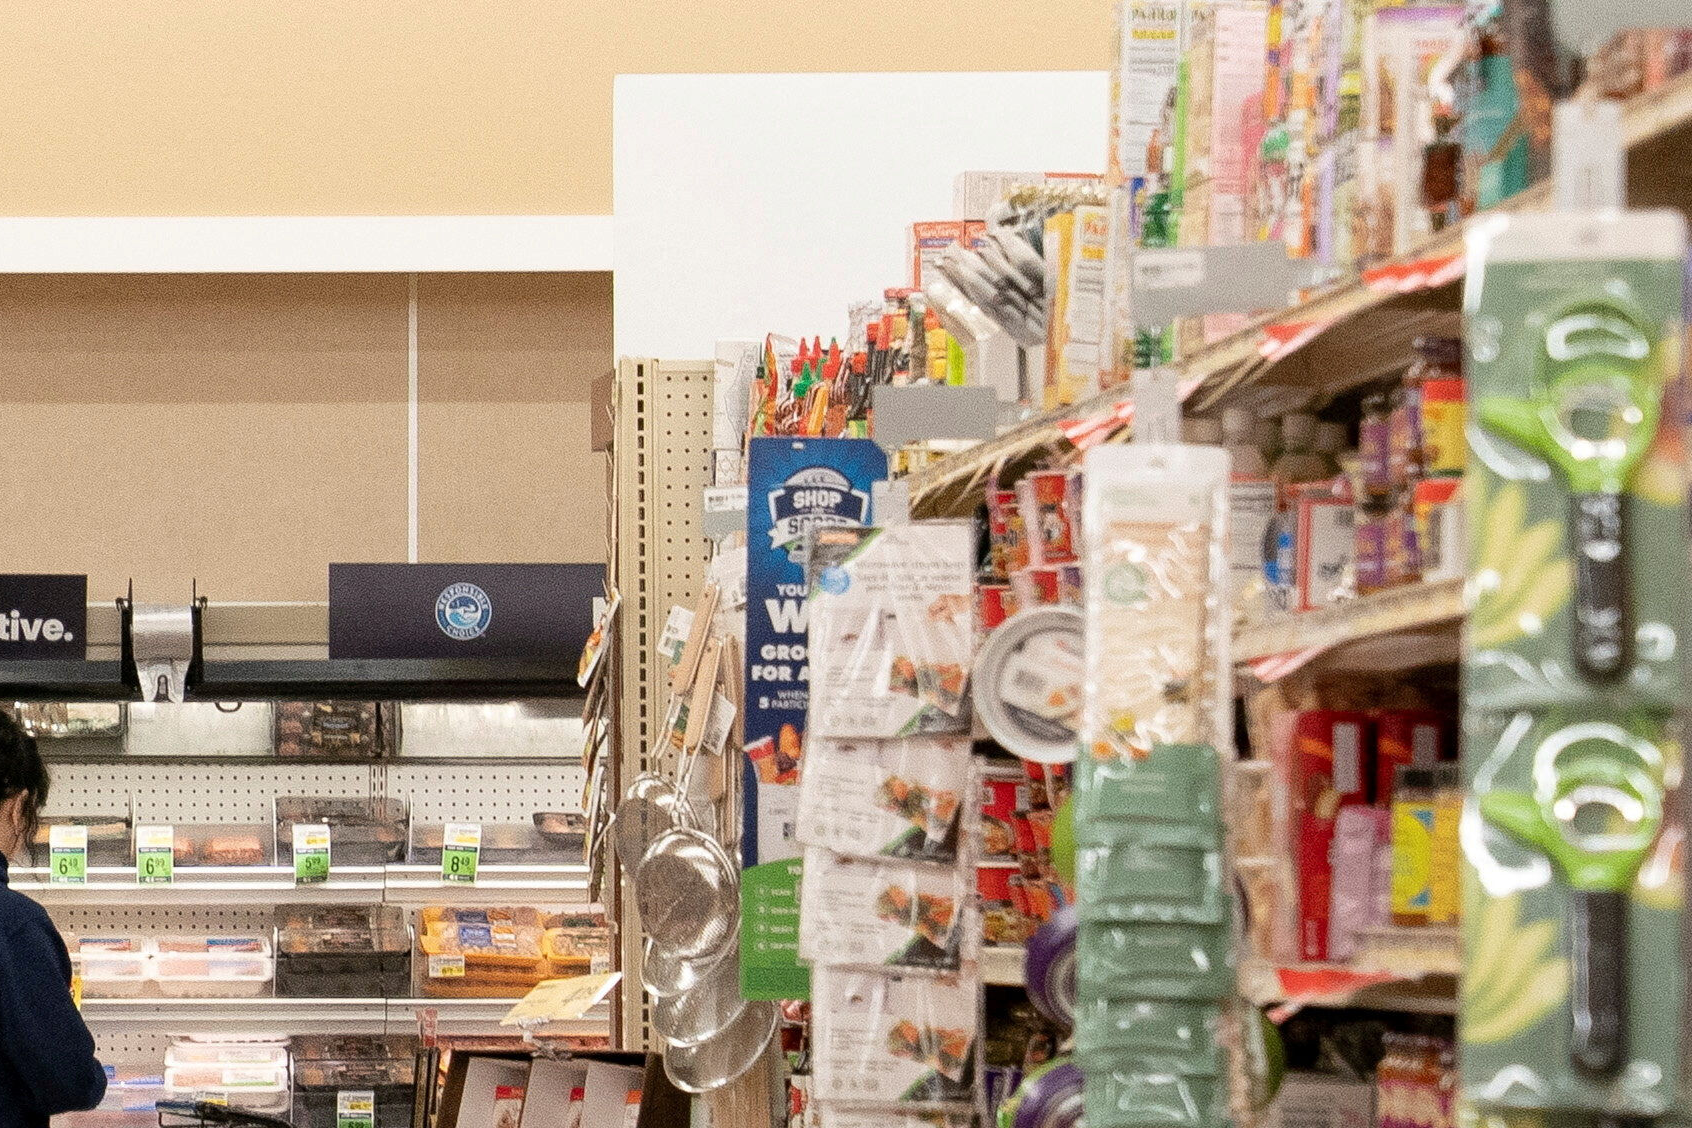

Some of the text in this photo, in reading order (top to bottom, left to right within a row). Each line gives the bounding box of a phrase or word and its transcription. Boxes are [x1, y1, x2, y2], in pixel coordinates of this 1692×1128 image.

[792, 489, 842, 509] SHOP
[760, 644, 809, 660] GRO
[751, 664, 792, 681] FOR
